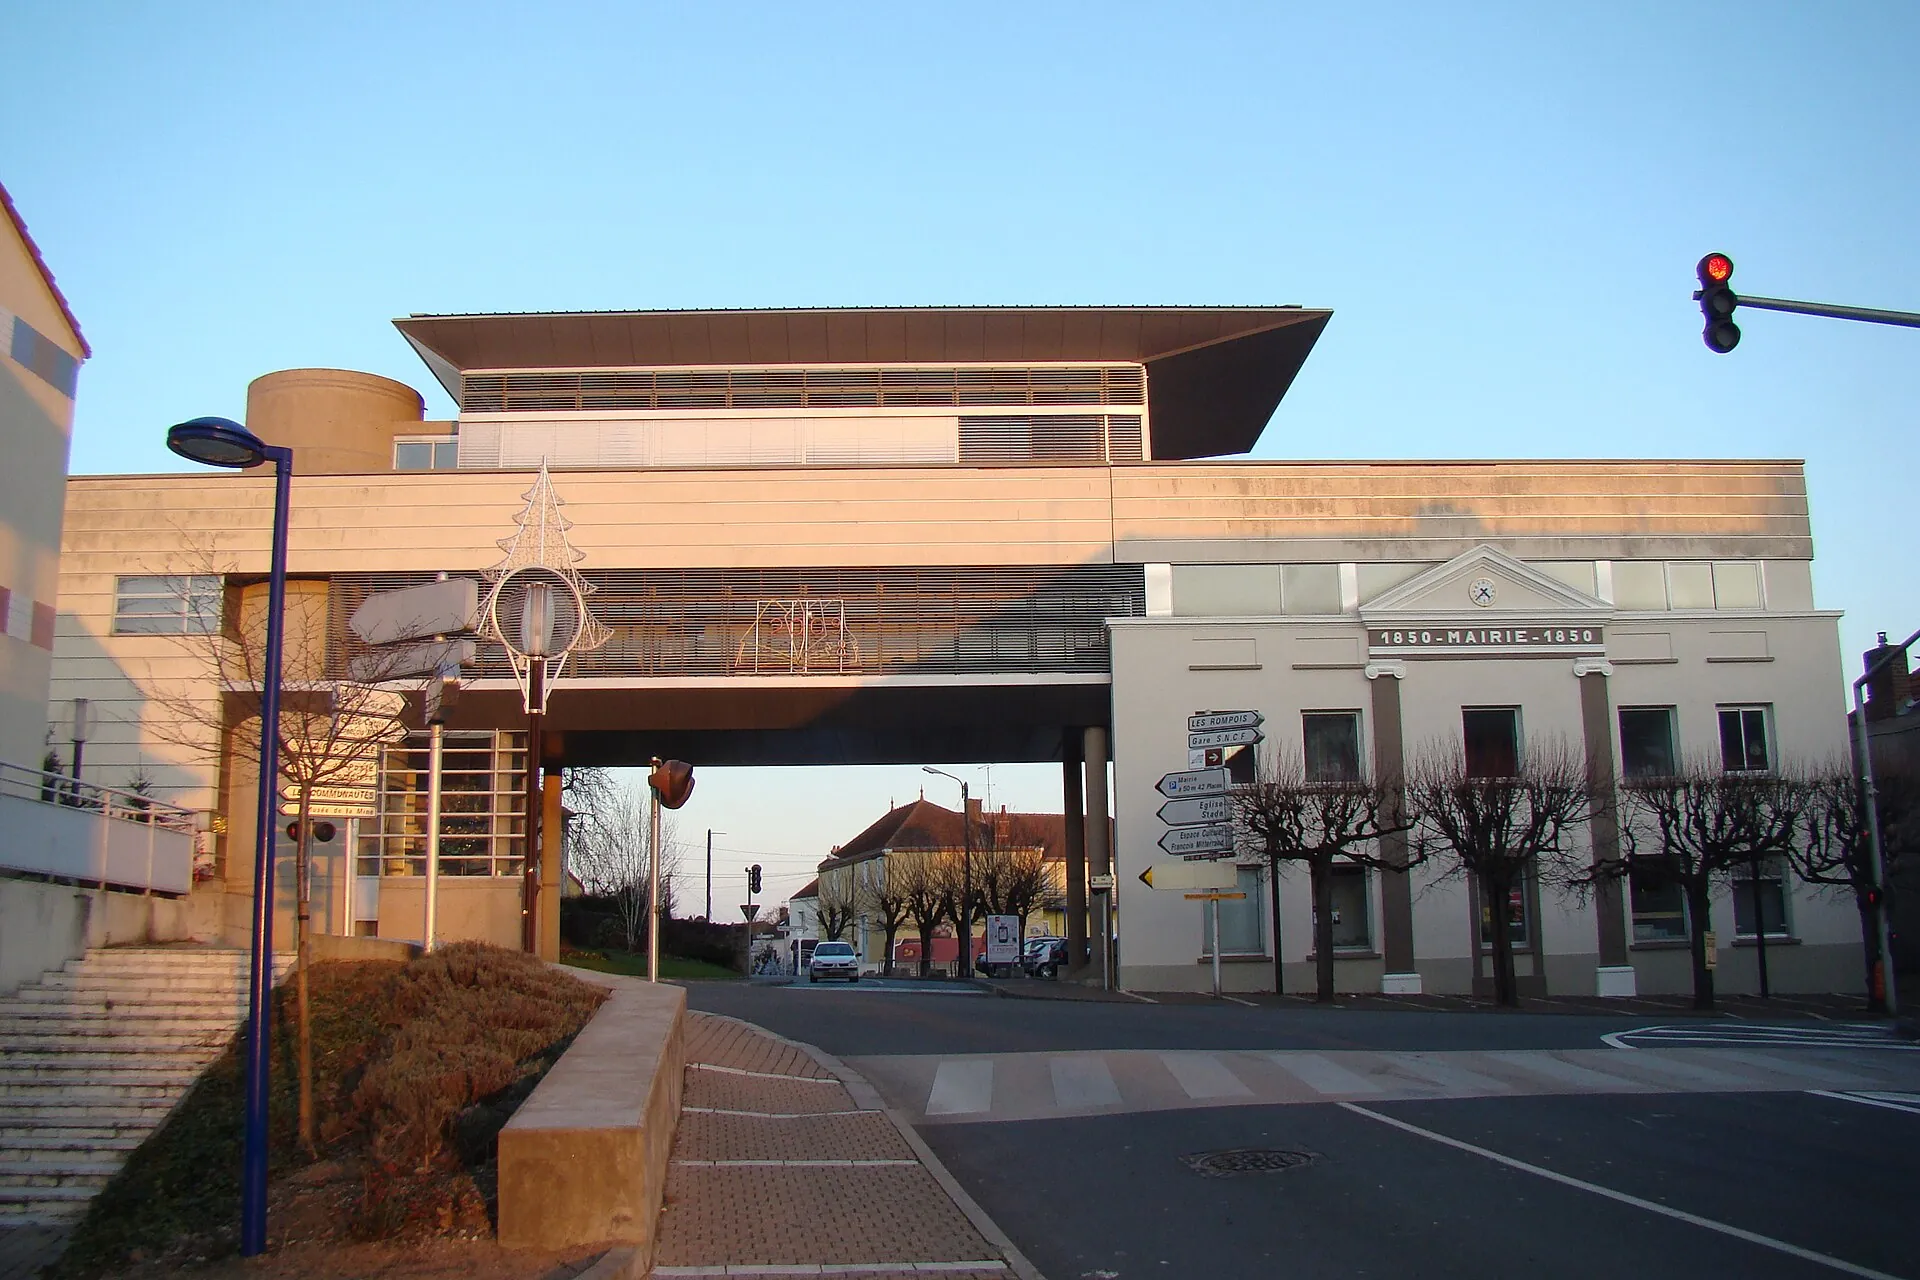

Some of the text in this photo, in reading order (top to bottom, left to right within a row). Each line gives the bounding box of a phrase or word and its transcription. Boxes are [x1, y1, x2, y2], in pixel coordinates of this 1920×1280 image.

[1191, 715, 1248, 727] LES ROMPOIS
[1192, 737, 1211, 745] Gare
[1199, 801, 1223, 810] Eglise
[1201, 810, 1224, 819] Stade
[1180, 831, 1199, 839] Espace
